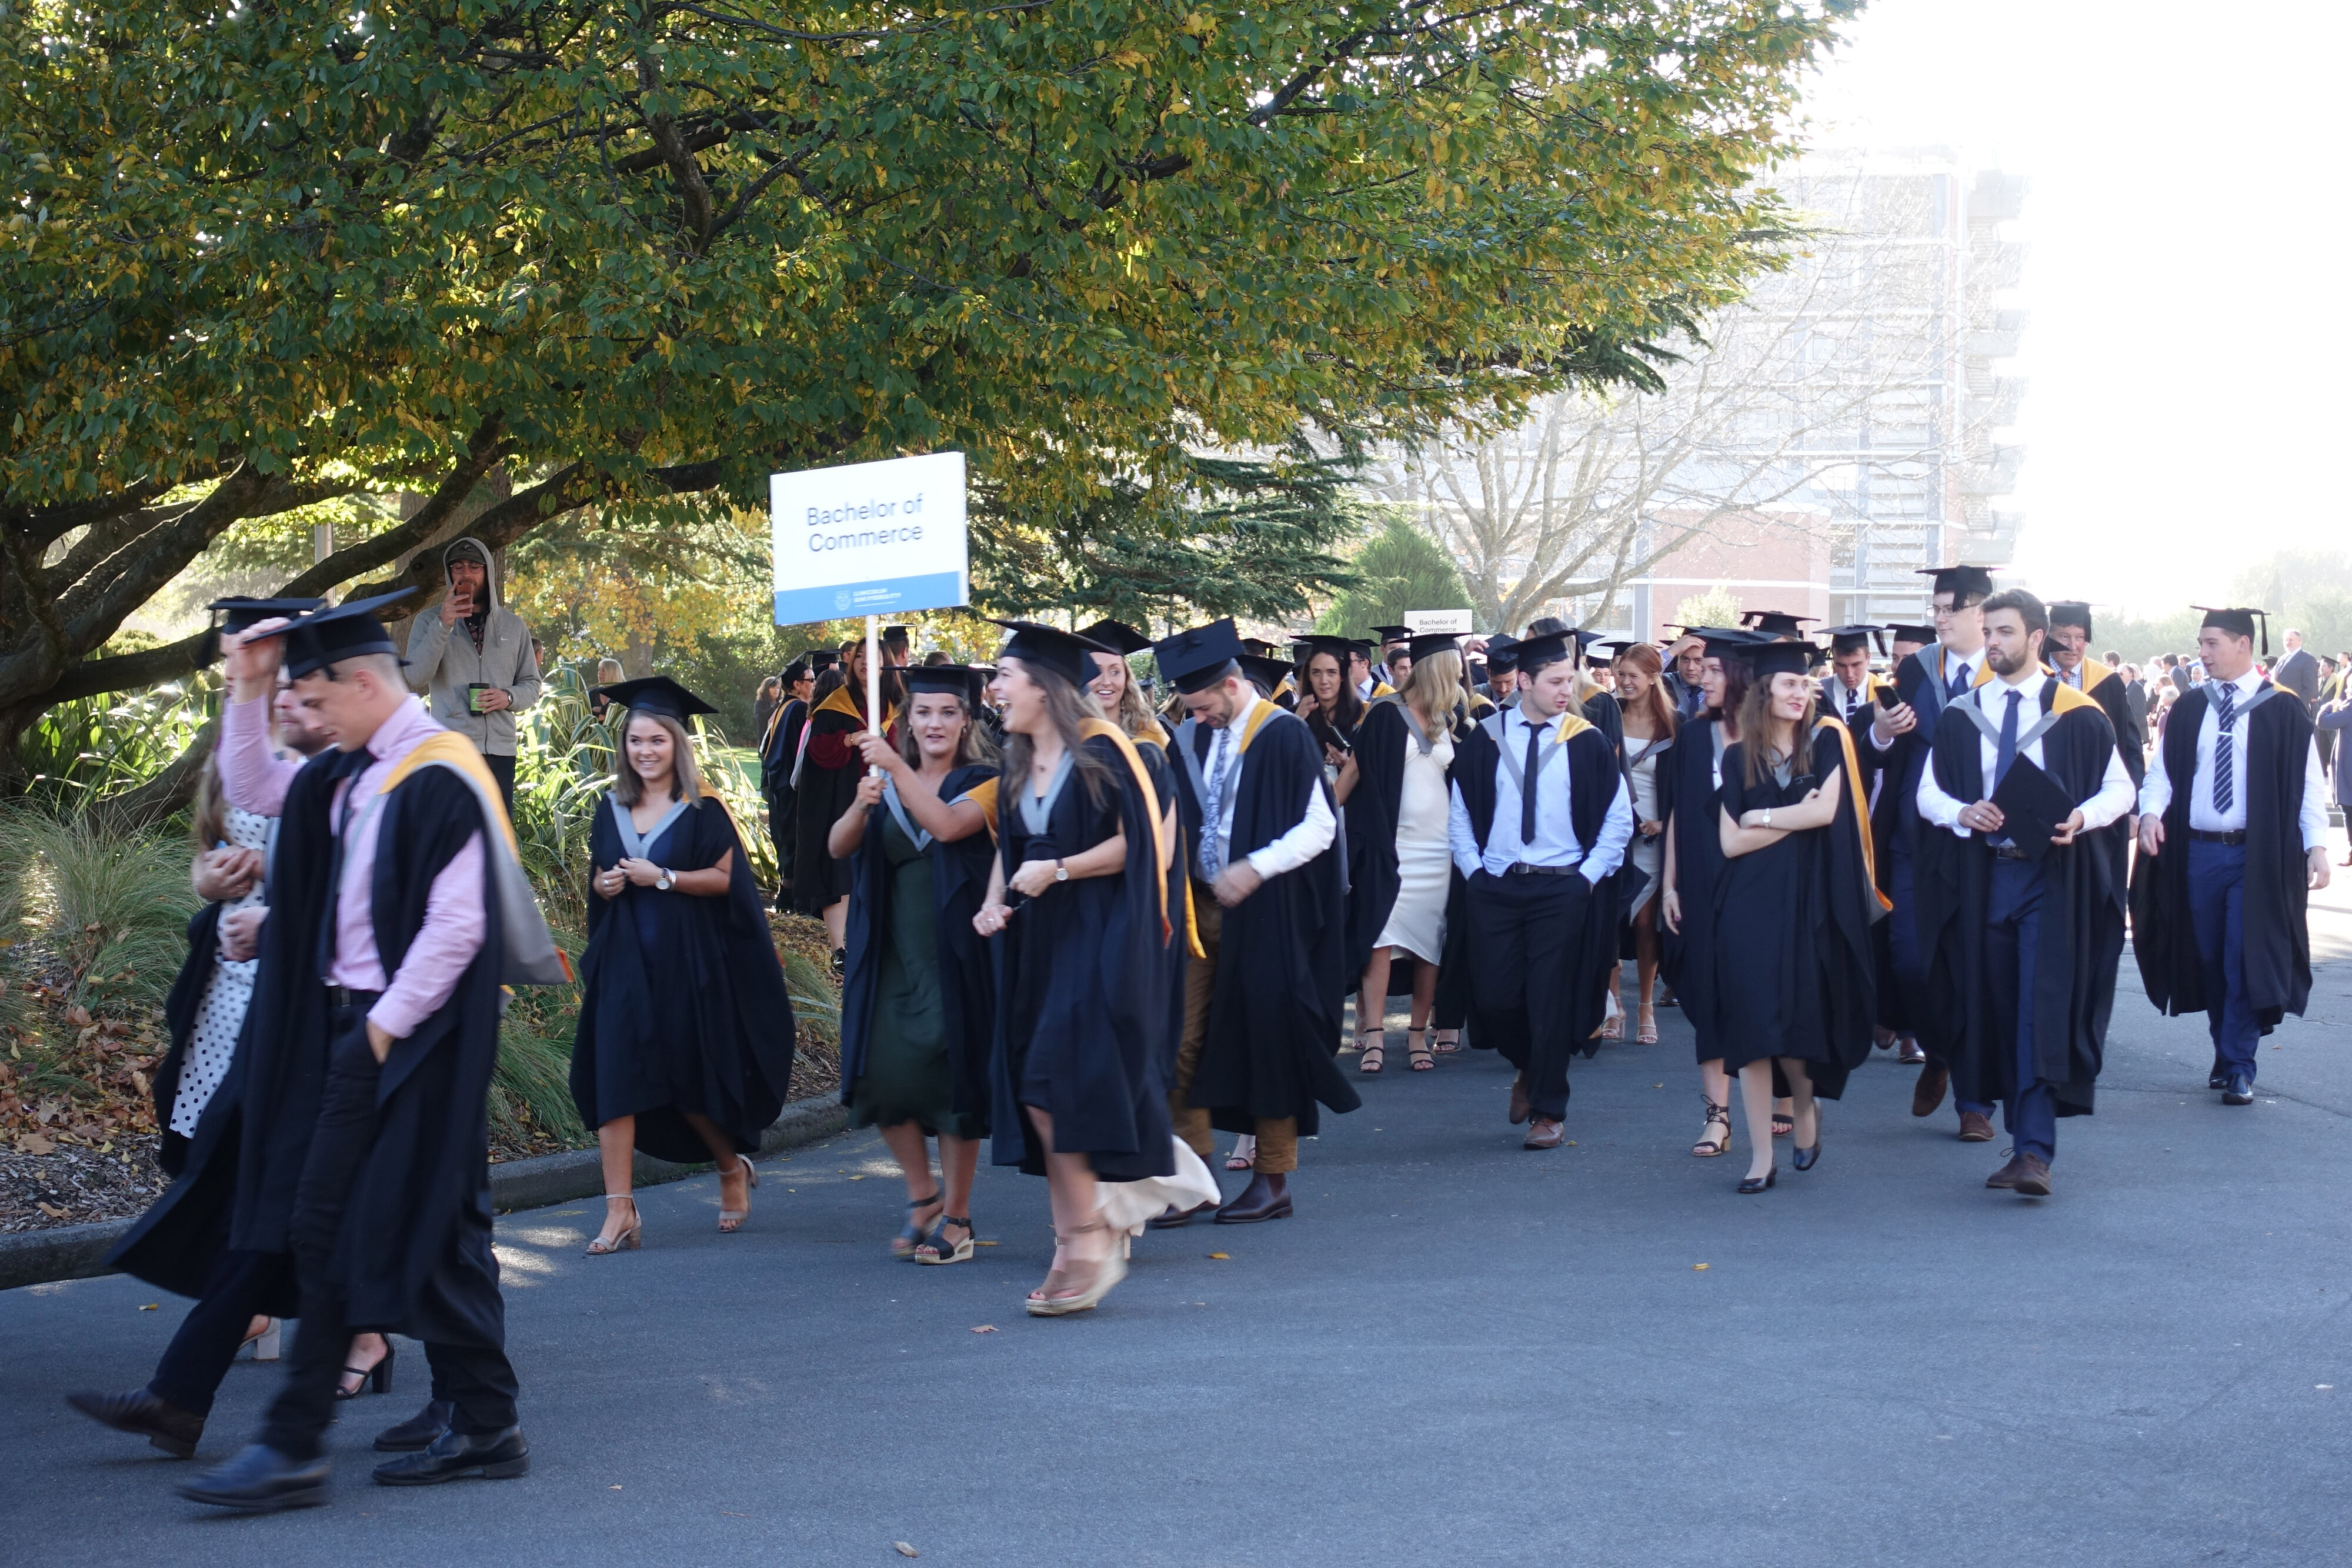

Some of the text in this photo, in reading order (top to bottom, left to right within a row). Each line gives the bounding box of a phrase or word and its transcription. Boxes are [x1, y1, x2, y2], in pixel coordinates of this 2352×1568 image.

[807, 493, 924, 526] Bachelor of
[809, 526, 924, 552] Commerce
